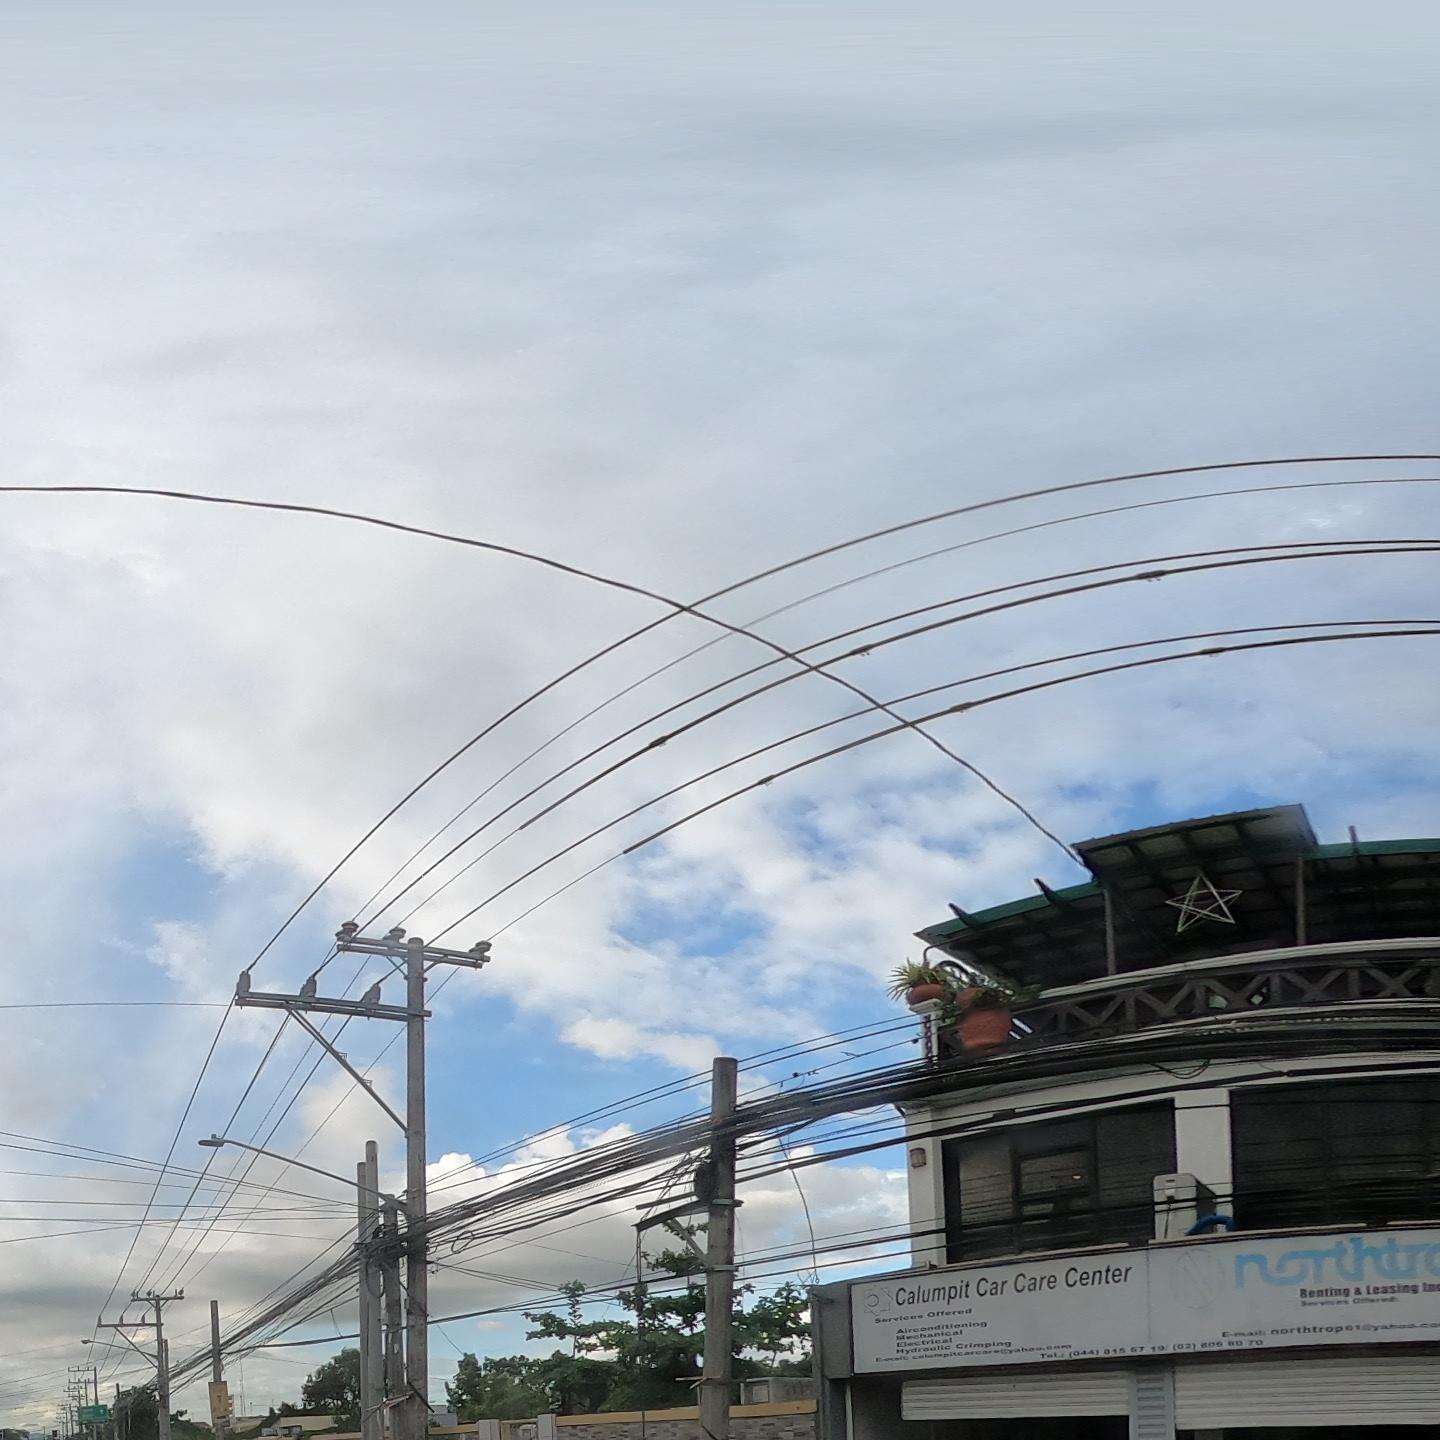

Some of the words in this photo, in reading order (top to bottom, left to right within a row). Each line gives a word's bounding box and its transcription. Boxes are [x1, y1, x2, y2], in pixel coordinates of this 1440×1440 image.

[895, 1280, 970, 1306] Calumpit
[976, 1276, 1008, 1298] Car
[1014, 1272, 1058, 1292] Care
[1065, 1264, 1133, 1289] Center
[1353, 1286, 1363, 1297] &
[1367, 1282, 1419, 1296] Leasing
[875, 1314, 923, 1324] Services
[928, 1308, 972, 1319] Offered
[895, 1319, 988, 1335] Airconditioning
[896, 1329, 963, 1341] Mechanical
[896, 1337, 954, 1349] Electrical
[896, 1343, 951, 1355] Hydraulic
[956, 1339, 1013, 1351] Crimping
[1069, 1349, 1100, 1359] (044)
